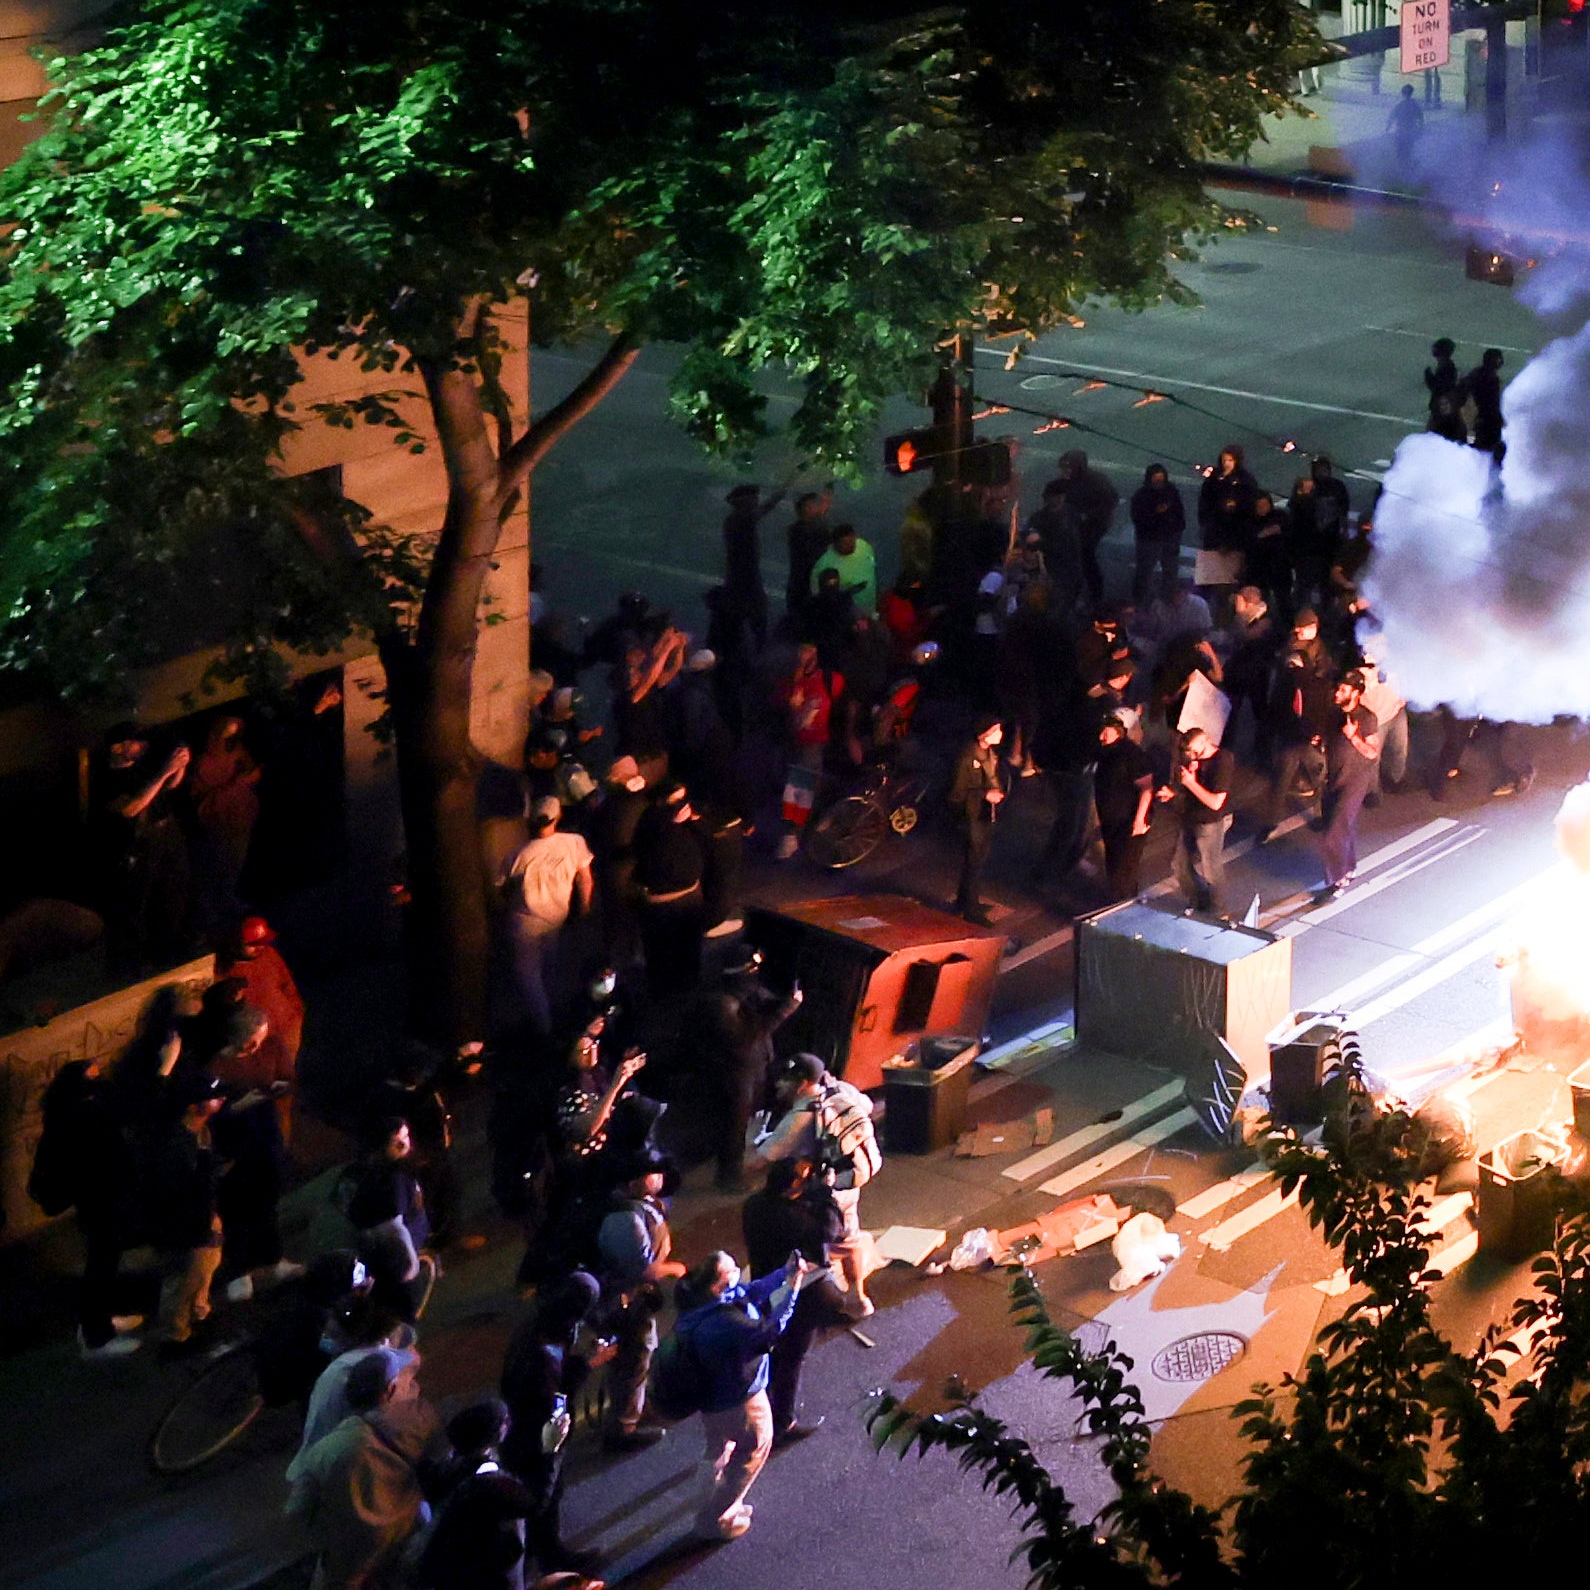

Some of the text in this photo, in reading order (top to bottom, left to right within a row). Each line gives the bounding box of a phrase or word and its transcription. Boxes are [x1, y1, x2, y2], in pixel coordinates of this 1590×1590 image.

[1415, 1, 1437, 18] NO
[1412, 20, 1440, 35] TURN
[1418, 37, 1433, 50] ON
[1415, 51, 1437, 66] RED
